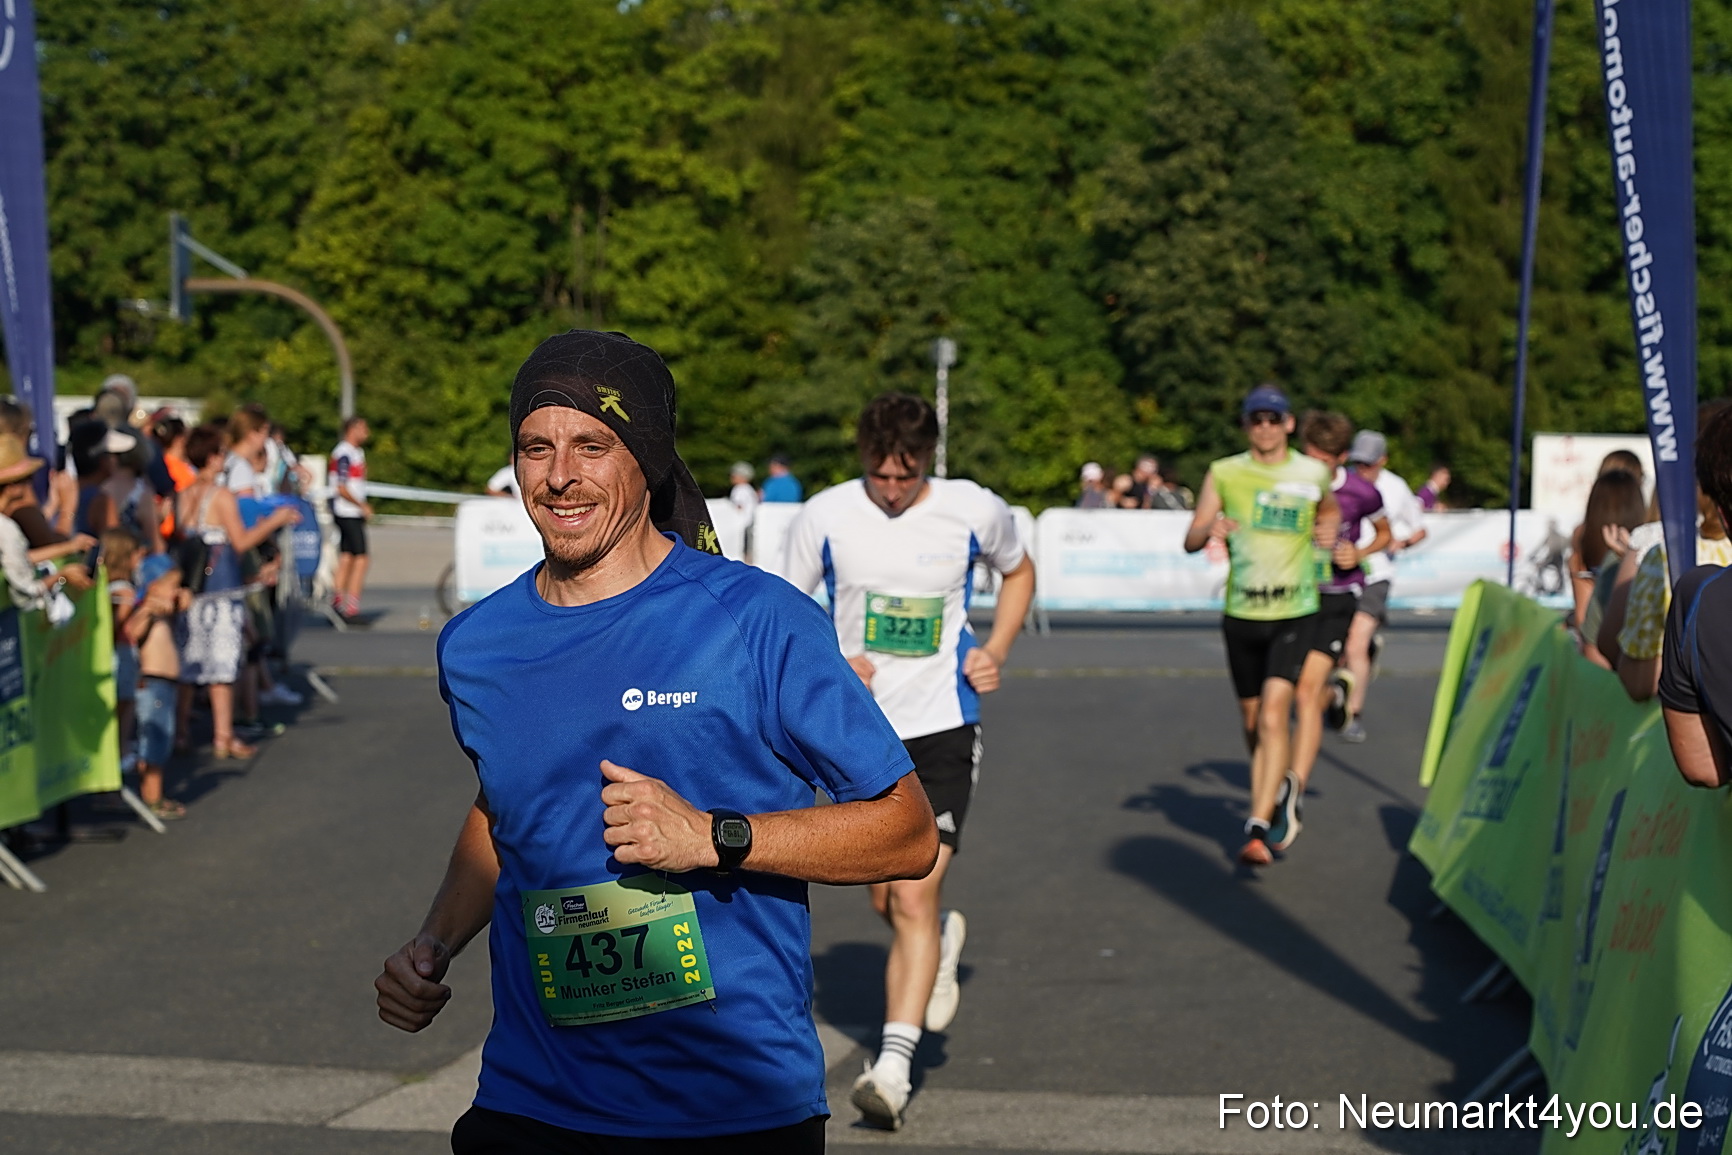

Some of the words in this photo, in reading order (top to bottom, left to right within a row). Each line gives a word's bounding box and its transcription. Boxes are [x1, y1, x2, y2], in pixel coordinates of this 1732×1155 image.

[884, 616, 927, 636] 323
[647, 690, 698, 709] Berger
[557, 907, 609, 926] Firmenlauf
[578, 917, 610, 928] neumarkt
[565, 924, 650, 978] 437
[673, 921, 701, 985] 2022
[537, 953, 557, 999] RUN
[560, 982, 617, 999] Munker
[622, 970, 677, 992] Stefan
[606, 1000, 624, 1008] Berger
[625, 996, 644, 1004] GmbH
